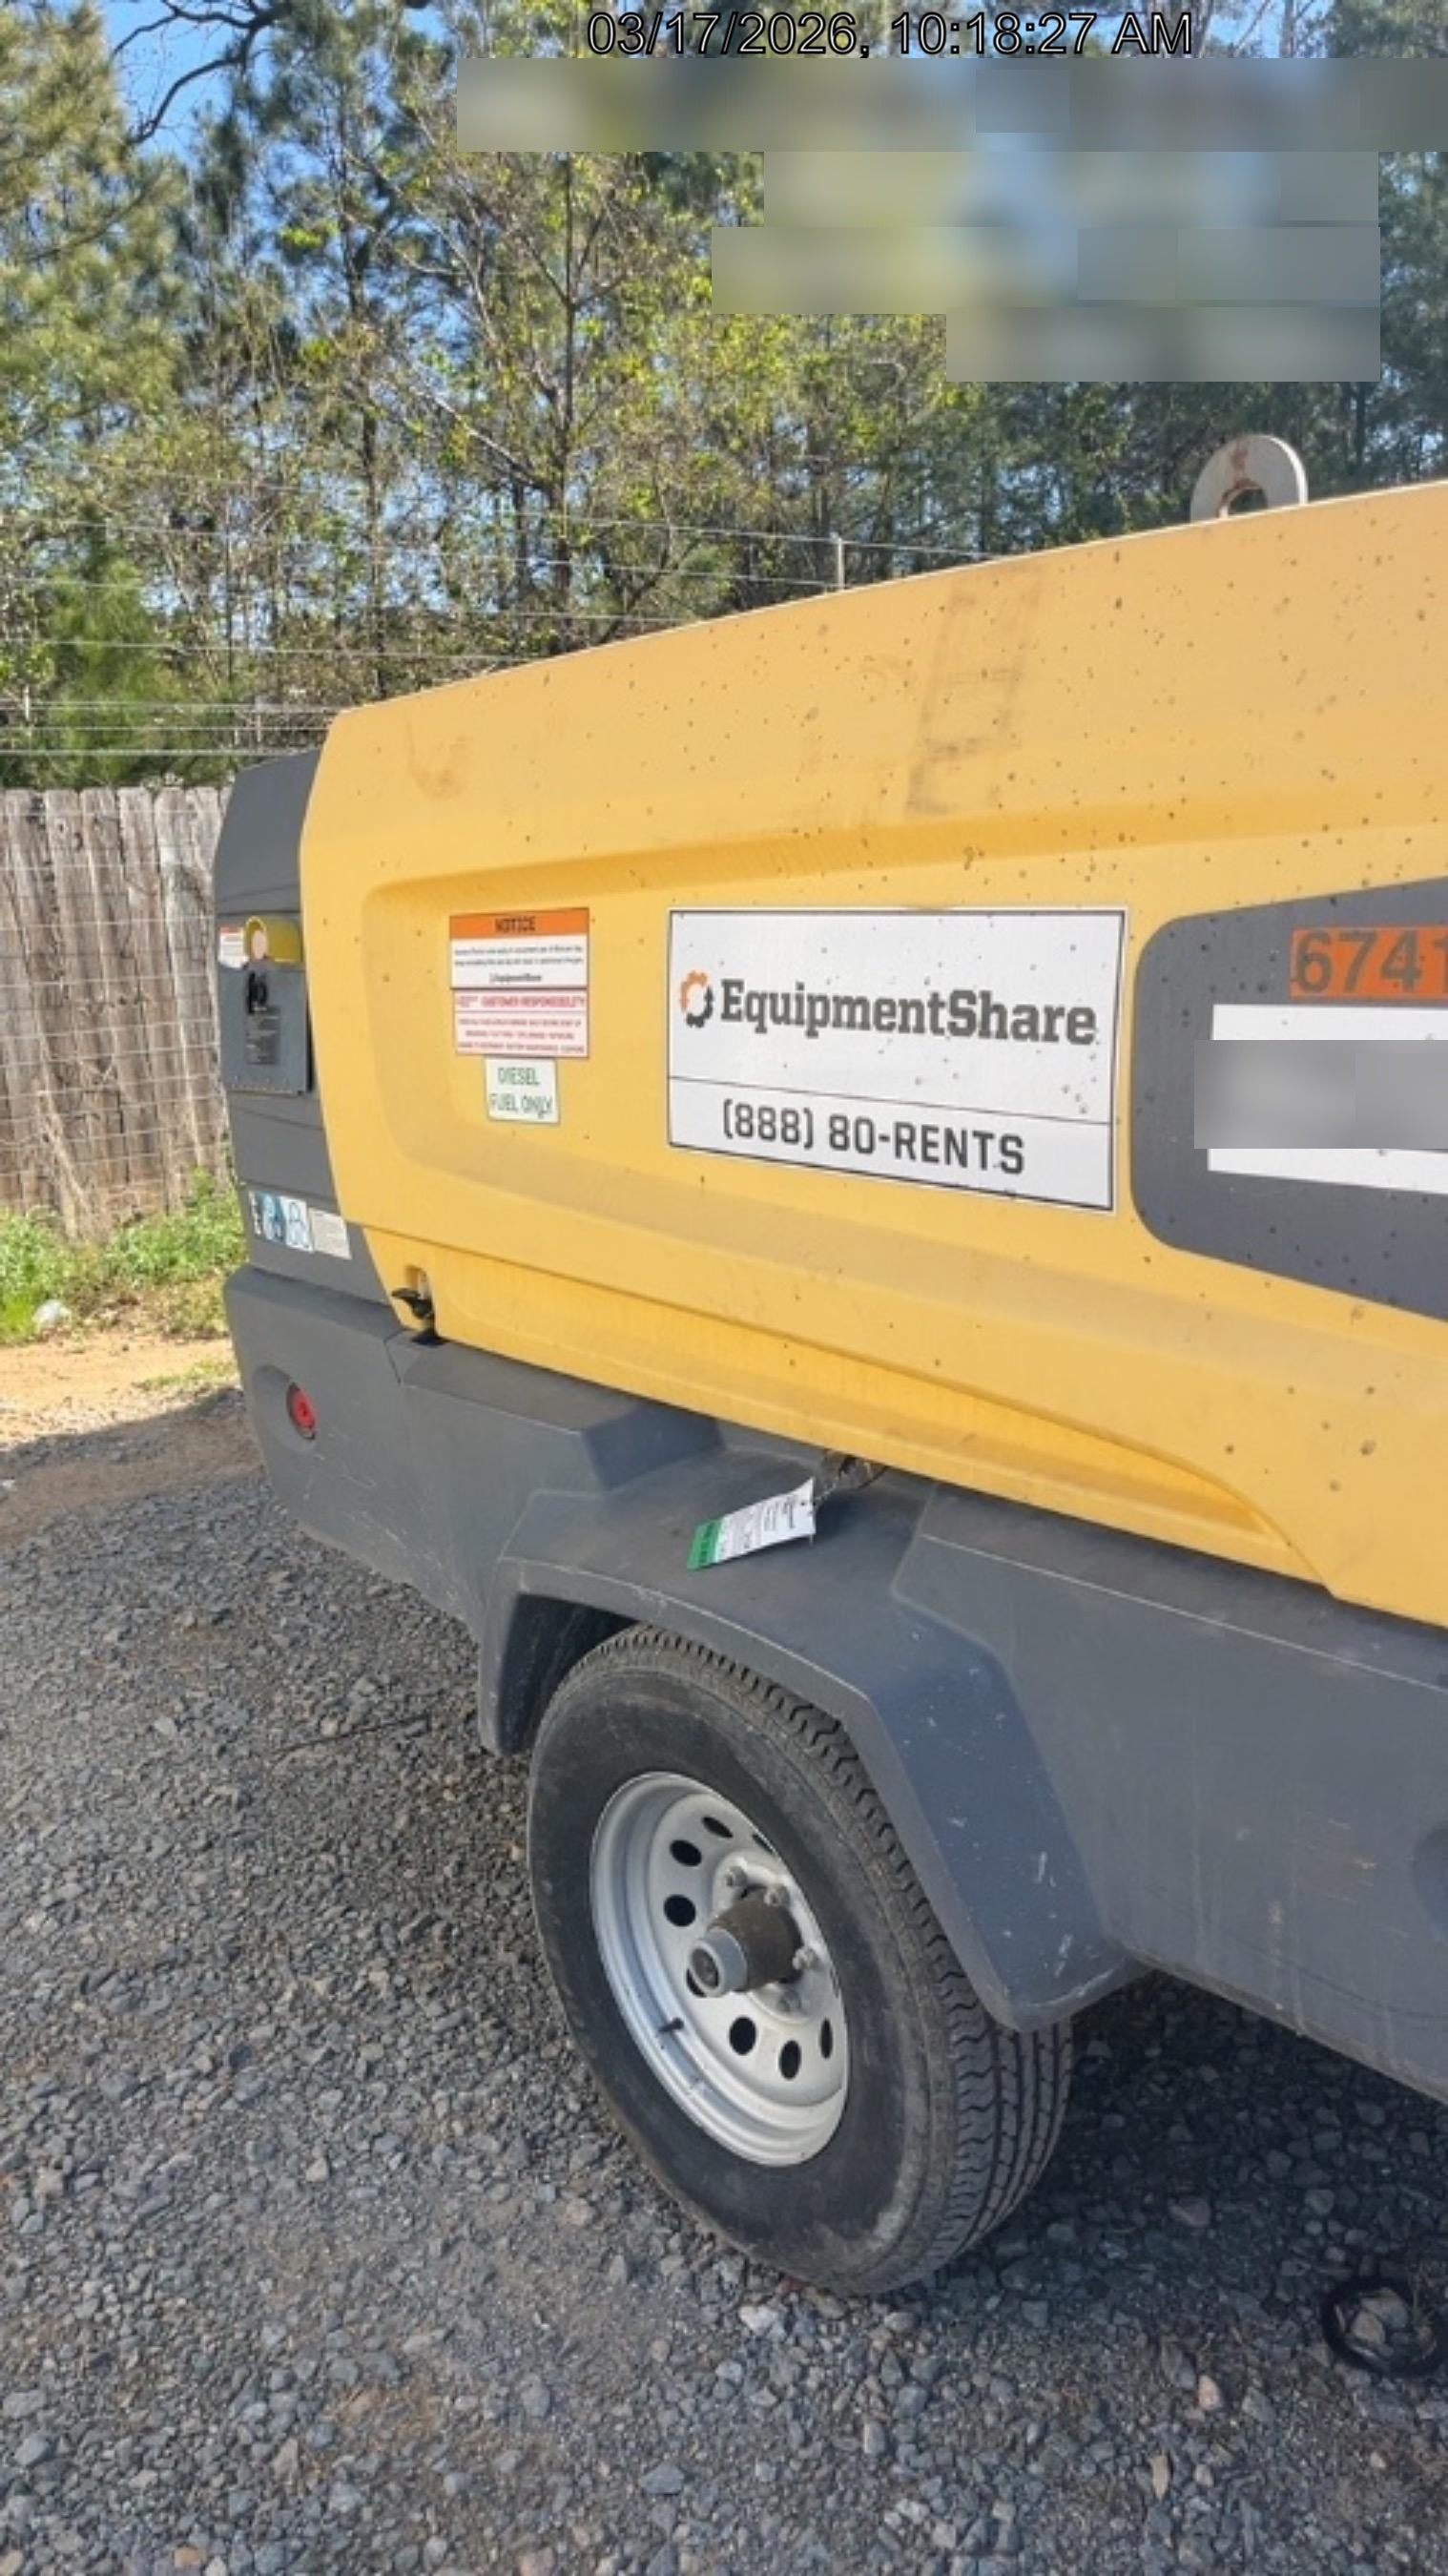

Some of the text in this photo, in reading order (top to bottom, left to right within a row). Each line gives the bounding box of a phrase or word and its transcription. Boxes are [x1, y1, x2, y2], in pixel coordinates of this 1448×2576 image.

[495, 916, 536, 932] NOTICE
[720, 978, 1096, 1046] EquipmentShare
[497, 1067, 539, 1086] DIESEL
[489, 1093, 551, 1116] FUEL ONLY
[722, 1099, 1025, 1175] (888) 80-RENTS
